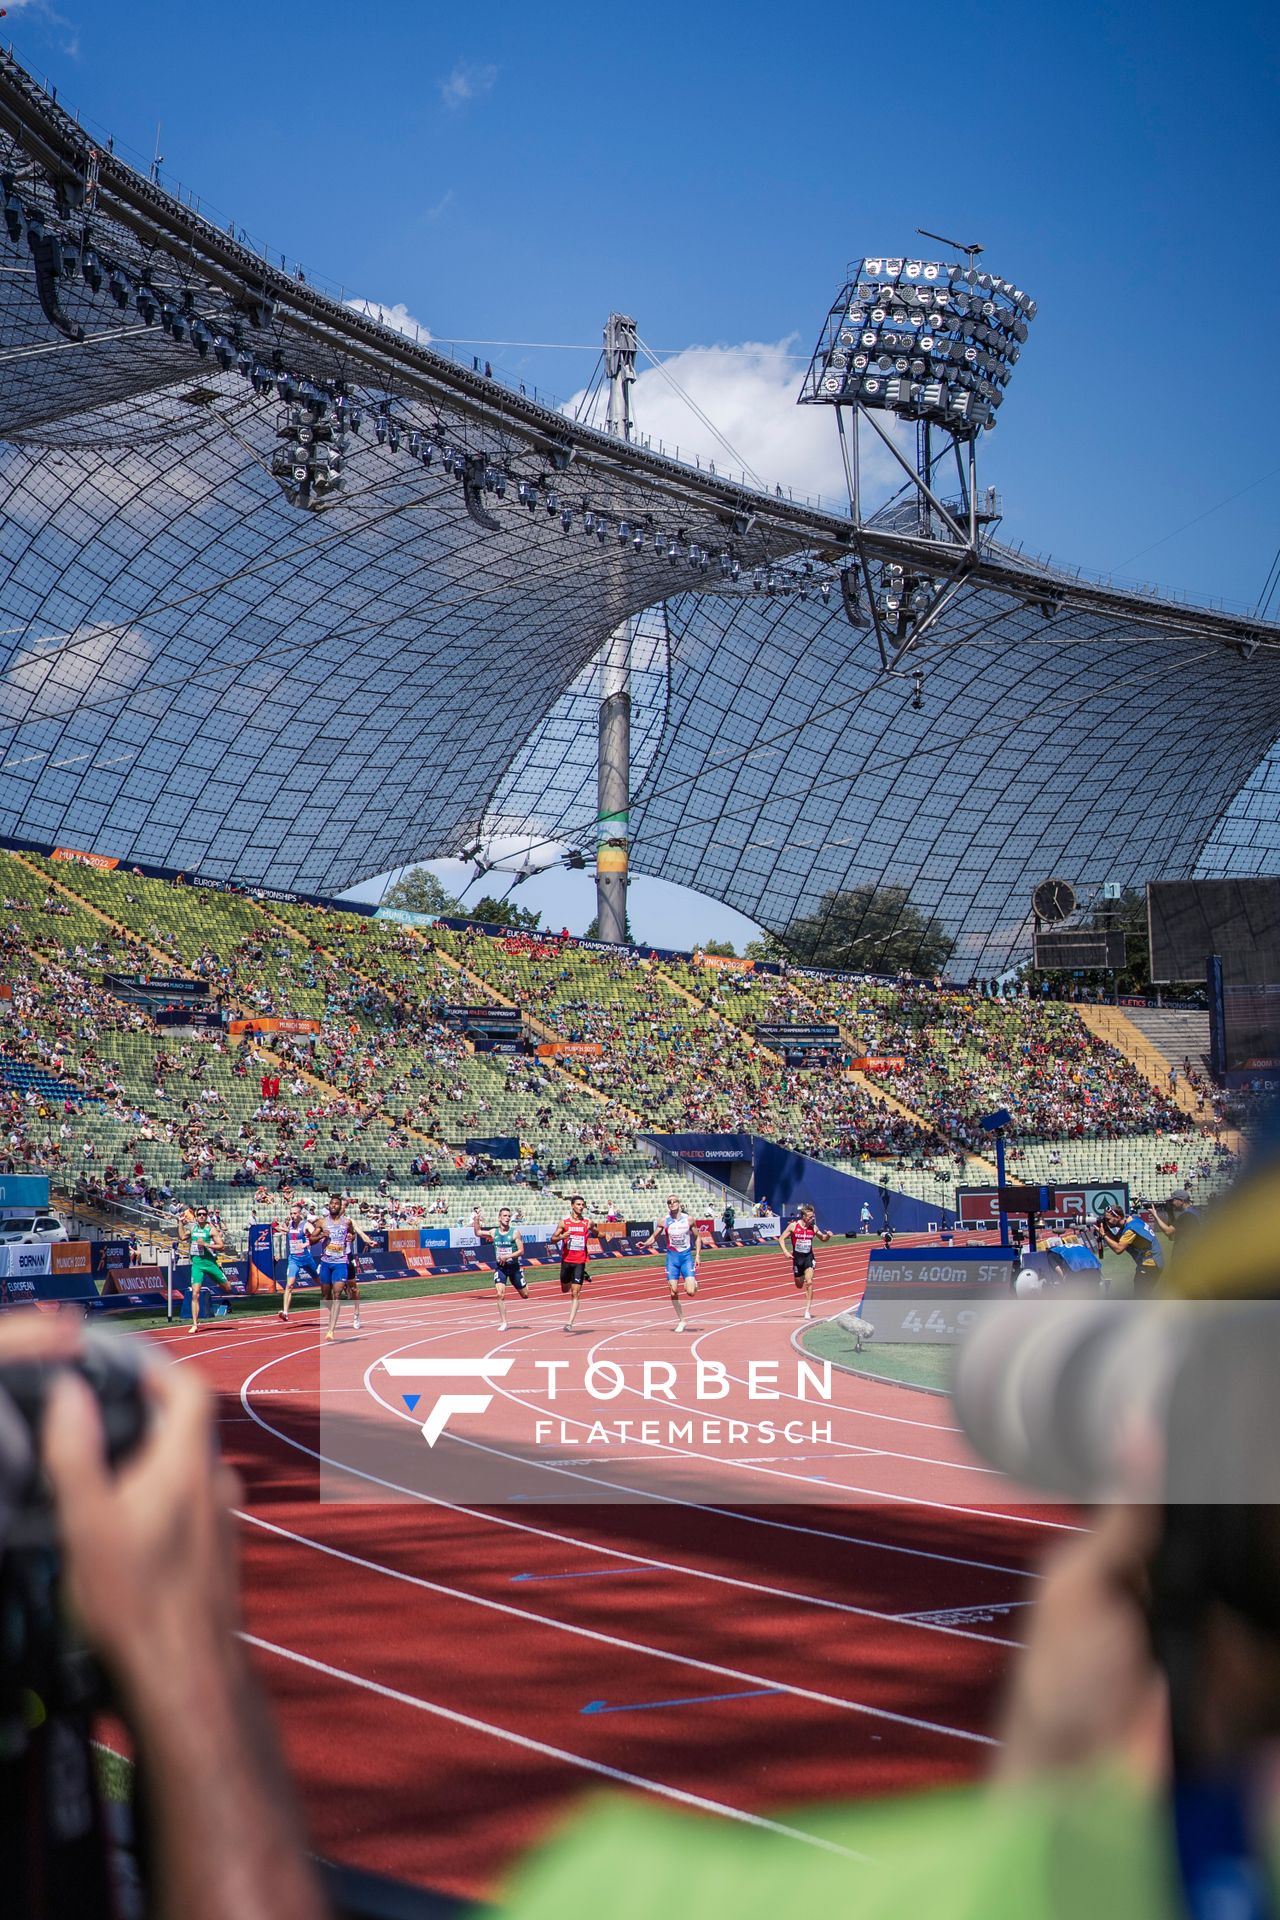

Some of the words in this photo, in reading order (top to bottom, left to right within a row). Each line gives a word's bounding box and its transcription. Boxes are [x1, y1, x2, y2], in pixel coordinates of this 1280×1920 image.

[193, 877, 232, 892] EUROPEN
[1109, 885, 1116, 896] 1
[727, 961, 745, 969] 2022
[19, 1254, 45, 1268] BORNAN
[56, 1257, 74, 1269] MUNICH
[74, 1255, 86, 1267] 2022
[868, 1265, 913, 1282] Men's
[918, 1266, 967, 1282] 400m
[118, 1277, 145, 1290] MUNICH
[145, 1276, 164, 1288] 2022
